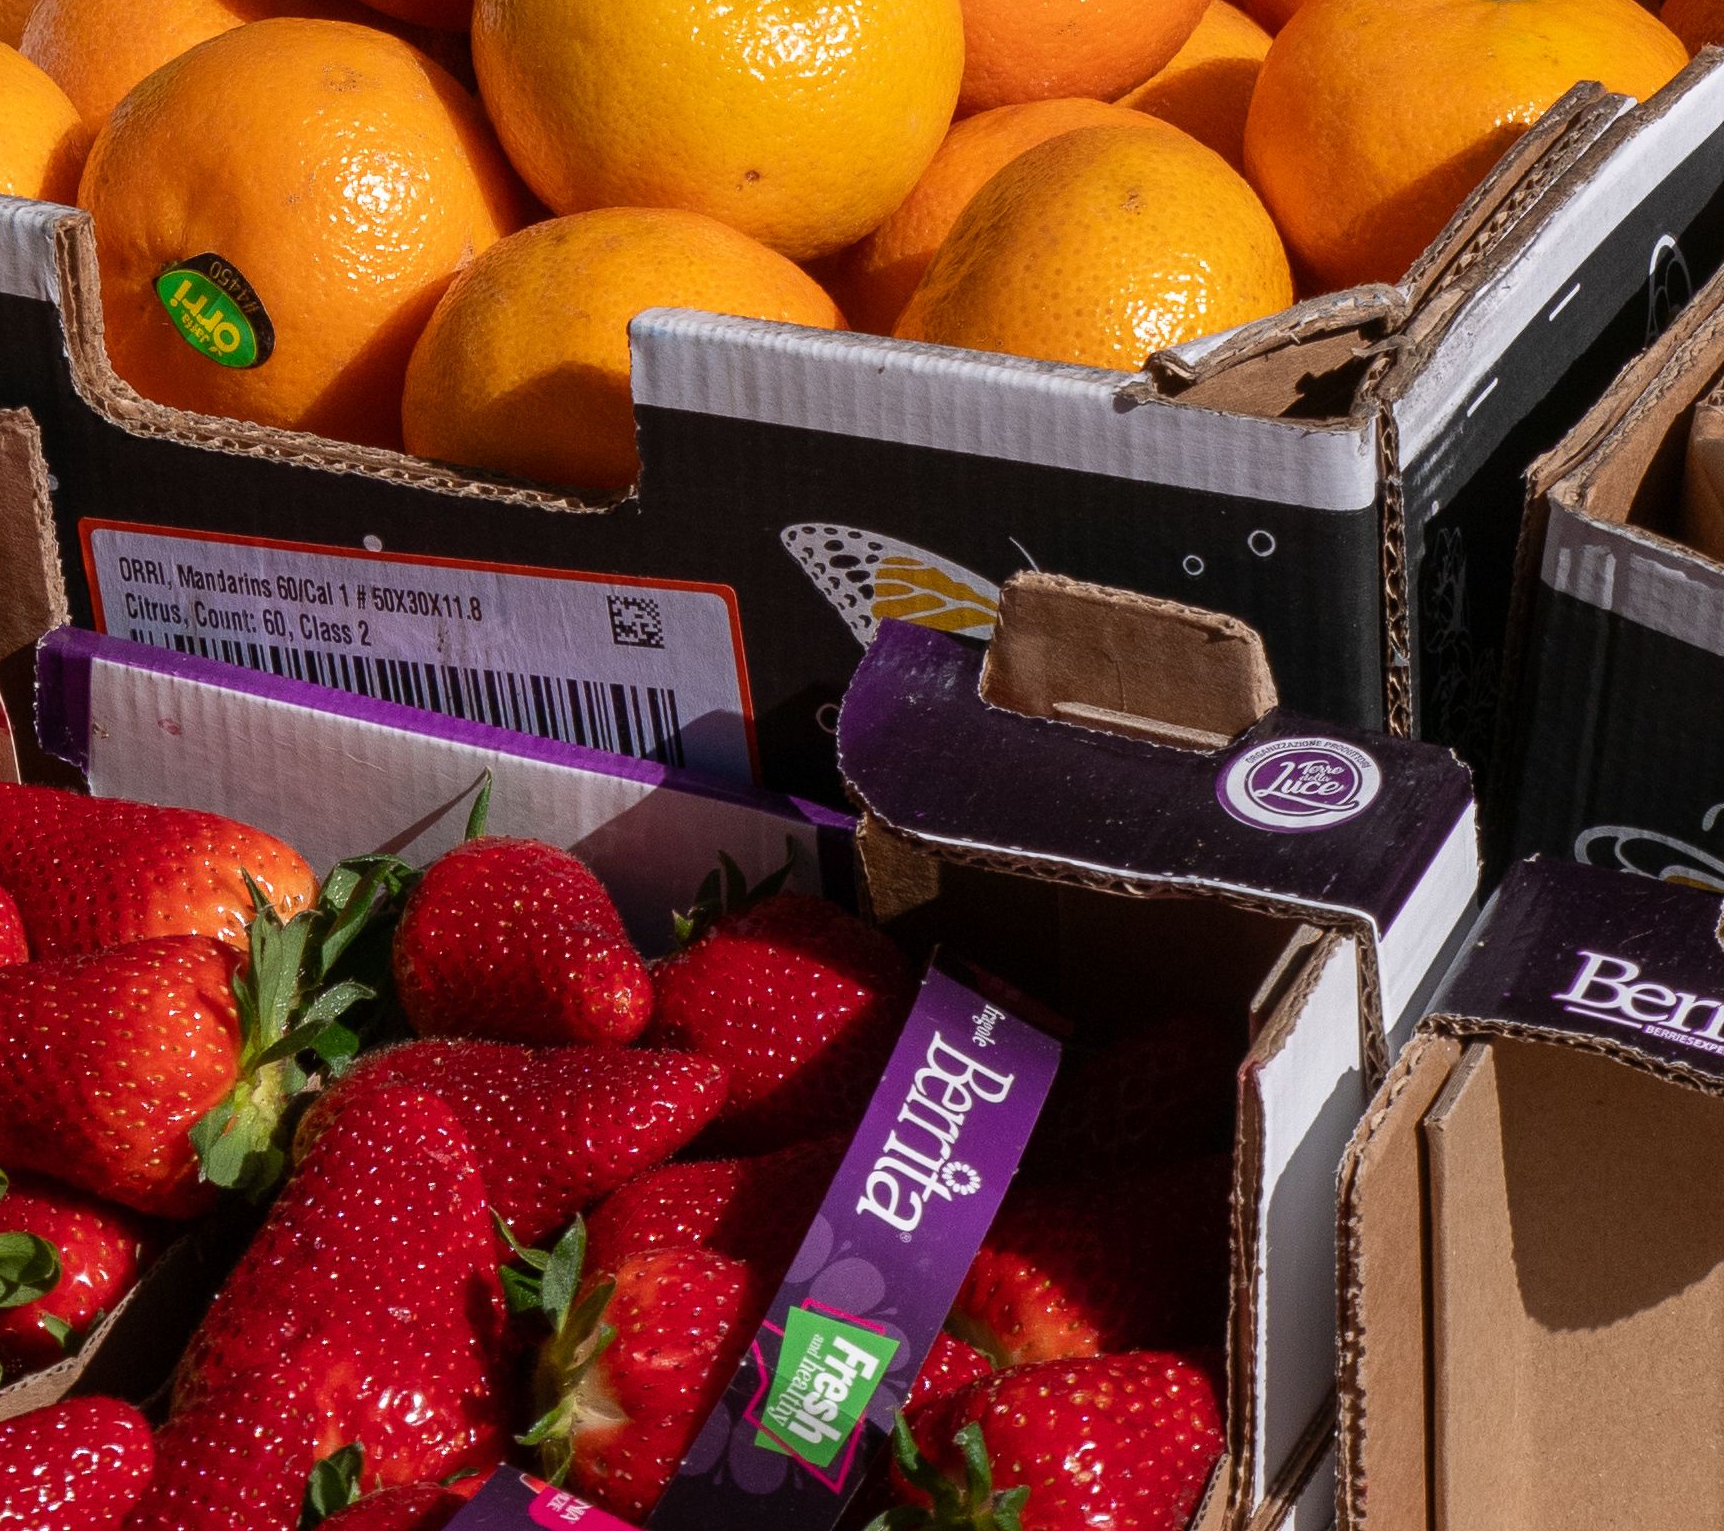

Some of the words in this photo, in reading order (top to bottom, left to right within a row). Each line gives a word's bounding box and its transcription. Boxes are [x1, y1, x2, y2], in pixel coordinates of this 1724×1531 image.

[169, 279, 241, 353] orri
[118, 556, 173, 589] ORRI,
[177, 563, 272, 600] Mandarins
[276, 576, 334, 607] 60/Cal
[338, 586, 349, 608] 1
[356, 588, 367, 610] #
[374, 588, 483, 623] 50X30X11.8
[125, 592, 190, 629] Citrus,
[193, 600, 257, 635] Count:
[262, 609, 294, 642] 60,
[300, 614, 353, 645] Class
[357, 621, 373, 648] 2
[1253, 761, 1352, 803] Luce
[855, 1030, 1015, 1233] Berrita
[767, 1358, 815, 1429] healthy
[789, 1335, 880, 1445] Fresh
